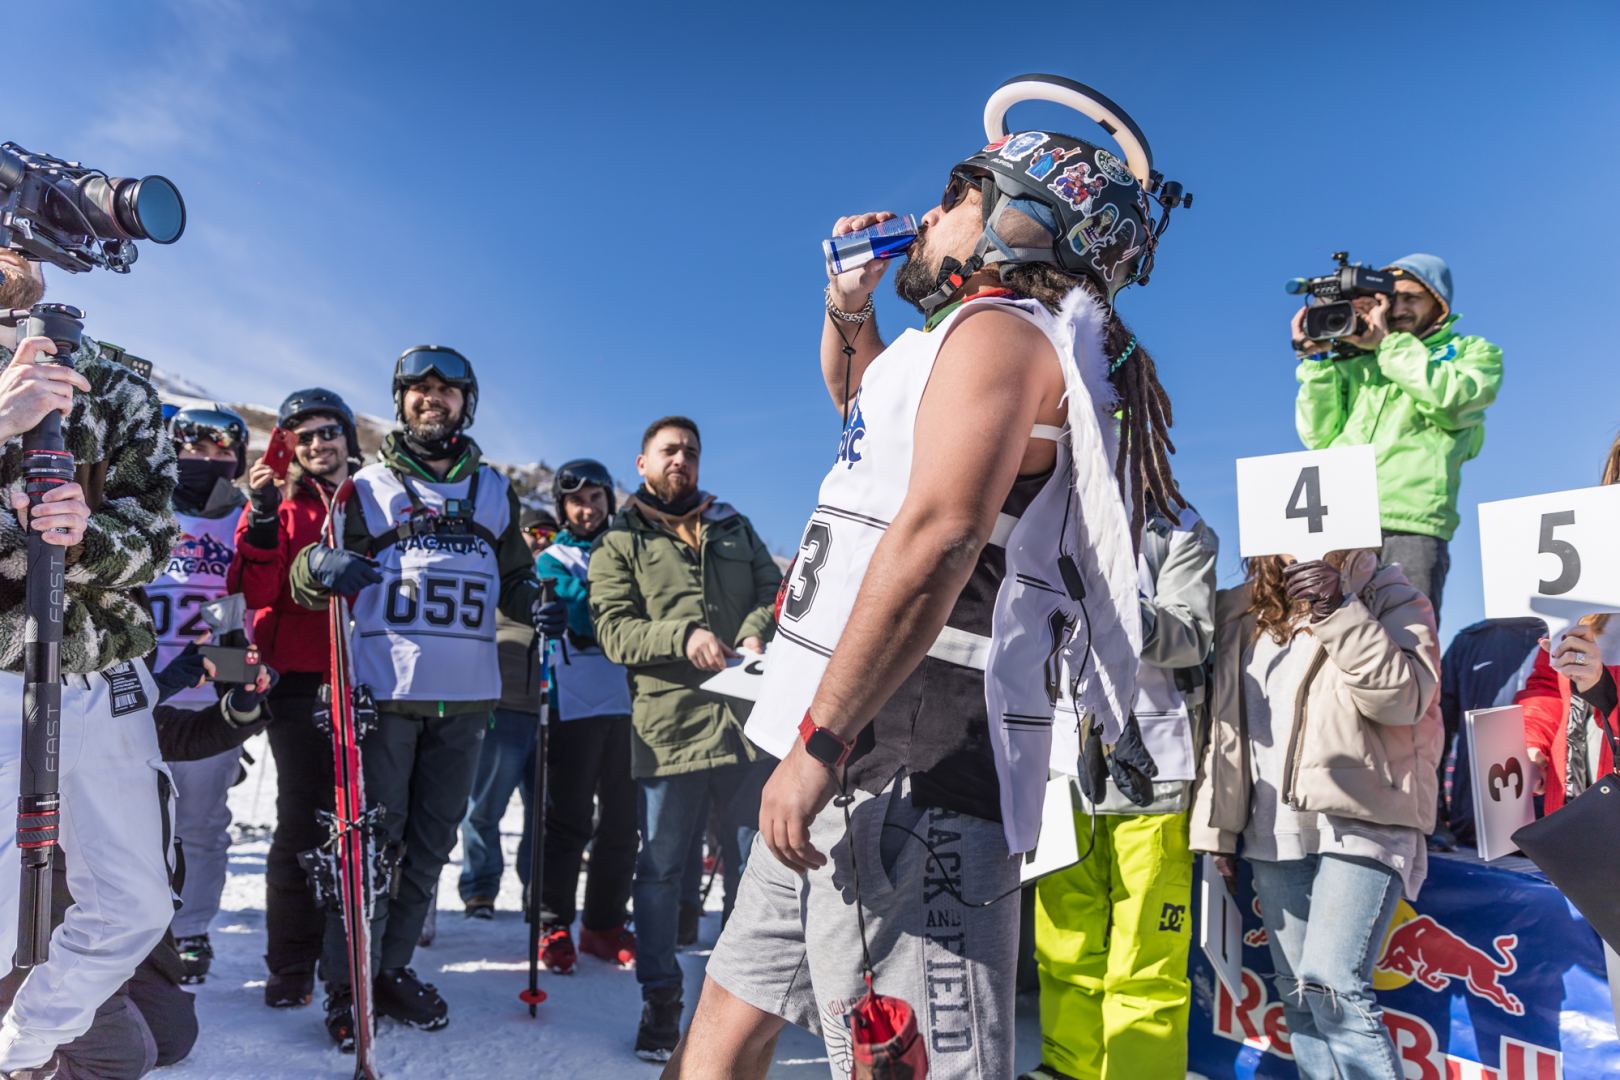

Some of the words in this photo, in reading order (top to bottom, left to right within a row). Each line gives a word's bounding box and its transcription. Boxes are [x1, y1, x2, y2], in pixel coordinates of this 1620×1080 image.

[1285, 466, 1328, 533] 4
[784, 520, 832, 622] 3
[1538, 510, 1581, 595] 5
[49, 555, 63, 623] FAST
[149, 594, 224, 635] 02
[384, 576, 488, 629] 055
[45, 703, 59, 773] FAST
[1488, 757, 1523, 802] 3
[926, 909, 961, 928] AND
[925, 932, 973, 1053] FIELD
